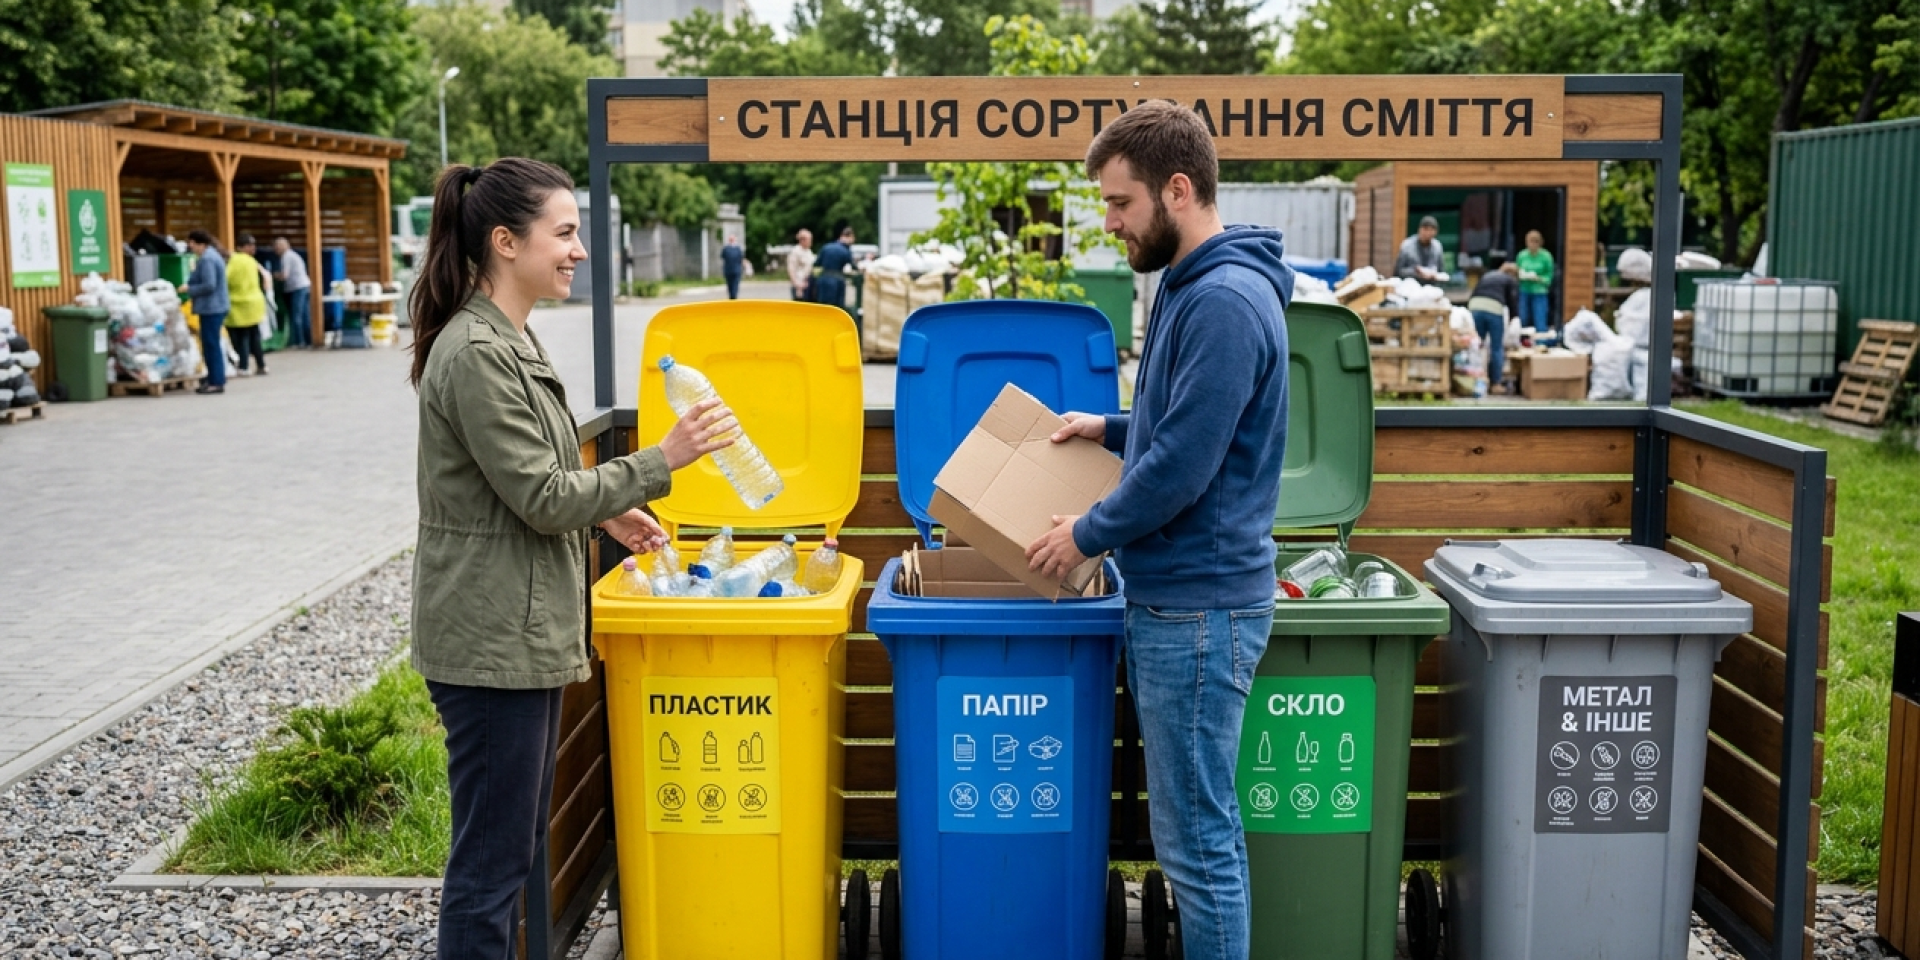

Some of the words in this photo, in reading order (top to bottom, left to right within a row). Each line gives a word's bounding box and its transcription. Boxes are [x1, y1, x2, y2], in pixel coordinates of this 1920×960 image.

[736, 99, 958, 146] СТАНЦІЯ
[976, 98, 1324, 138] СОРТАННЯ
[1342, 98, 1534, 137] СМІТТЯ
[649, 694, 772, 716] ПЛАСТИК
[962, 693, 1049, 716] ПАПІР
[1267, 693, 1345, 716] СКЛО
[1562, 685, 1652, 707] МЕТАЛ
[1560, 711, 1579, 733] &
[1585, 711, 1653, 733] ІНШЕ
